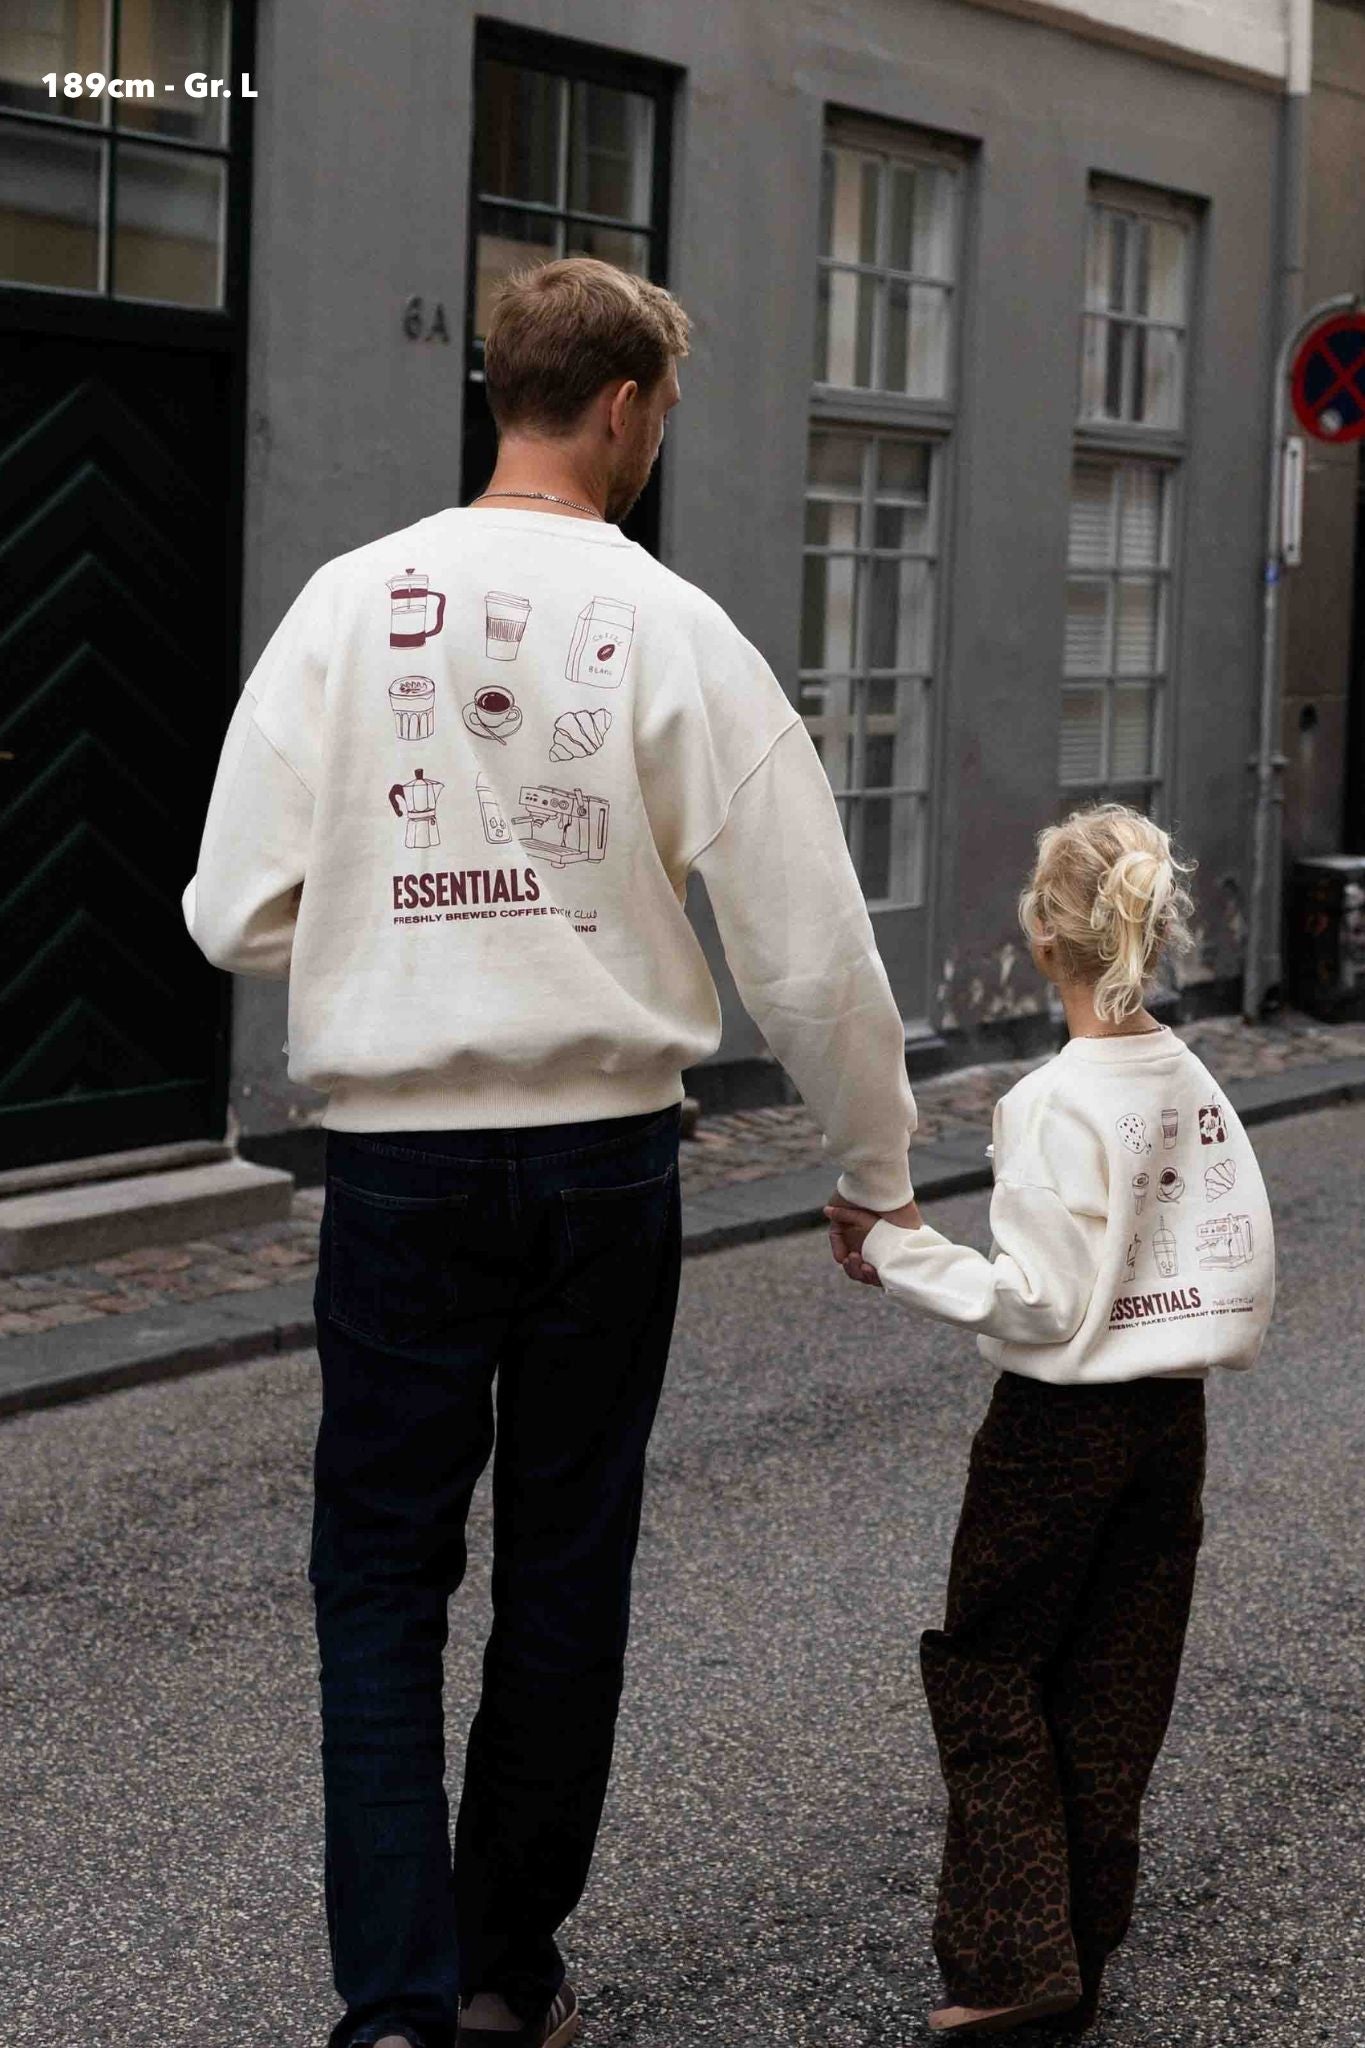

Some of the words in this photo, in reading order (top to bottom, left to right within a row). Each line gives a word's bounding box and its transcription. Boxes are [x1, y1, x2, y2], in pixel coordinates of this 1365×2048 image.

[404, 296, 451, 343] 6A
[393, 867, 540, 910] ESSENTIALS
[393, 914, 443, 925] FRESHLY
[445, 910, 497, 921] BREWED
[499, 907, 548, 918] COFFEE
[1141, 1316, 1168, 1327] BAKED
